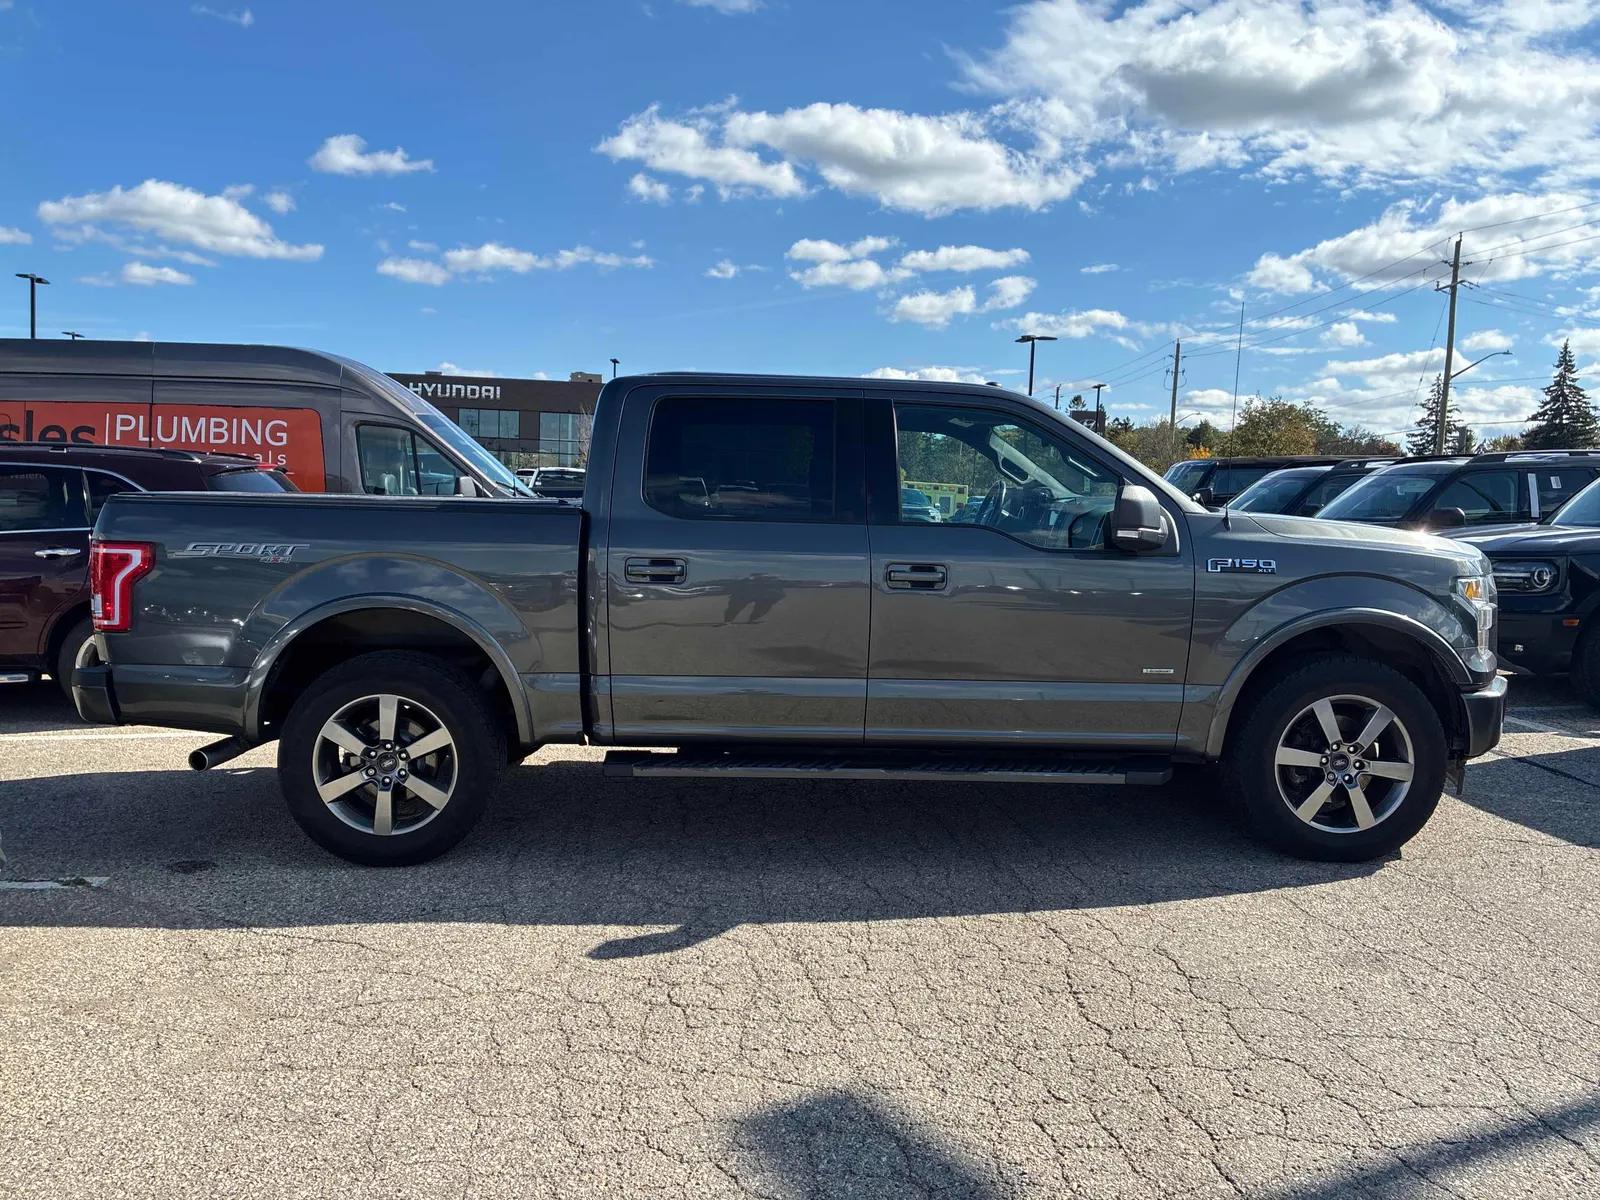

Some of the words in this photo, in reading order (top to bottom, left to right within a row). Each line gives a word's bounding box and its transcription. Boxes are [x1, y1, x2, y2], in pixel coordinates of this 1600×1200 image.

[408, 382, 500, 400] HYUNDAI
[116, 414, 288, 446] PLUMBING
[173, 541, 310, 557] SPORT
